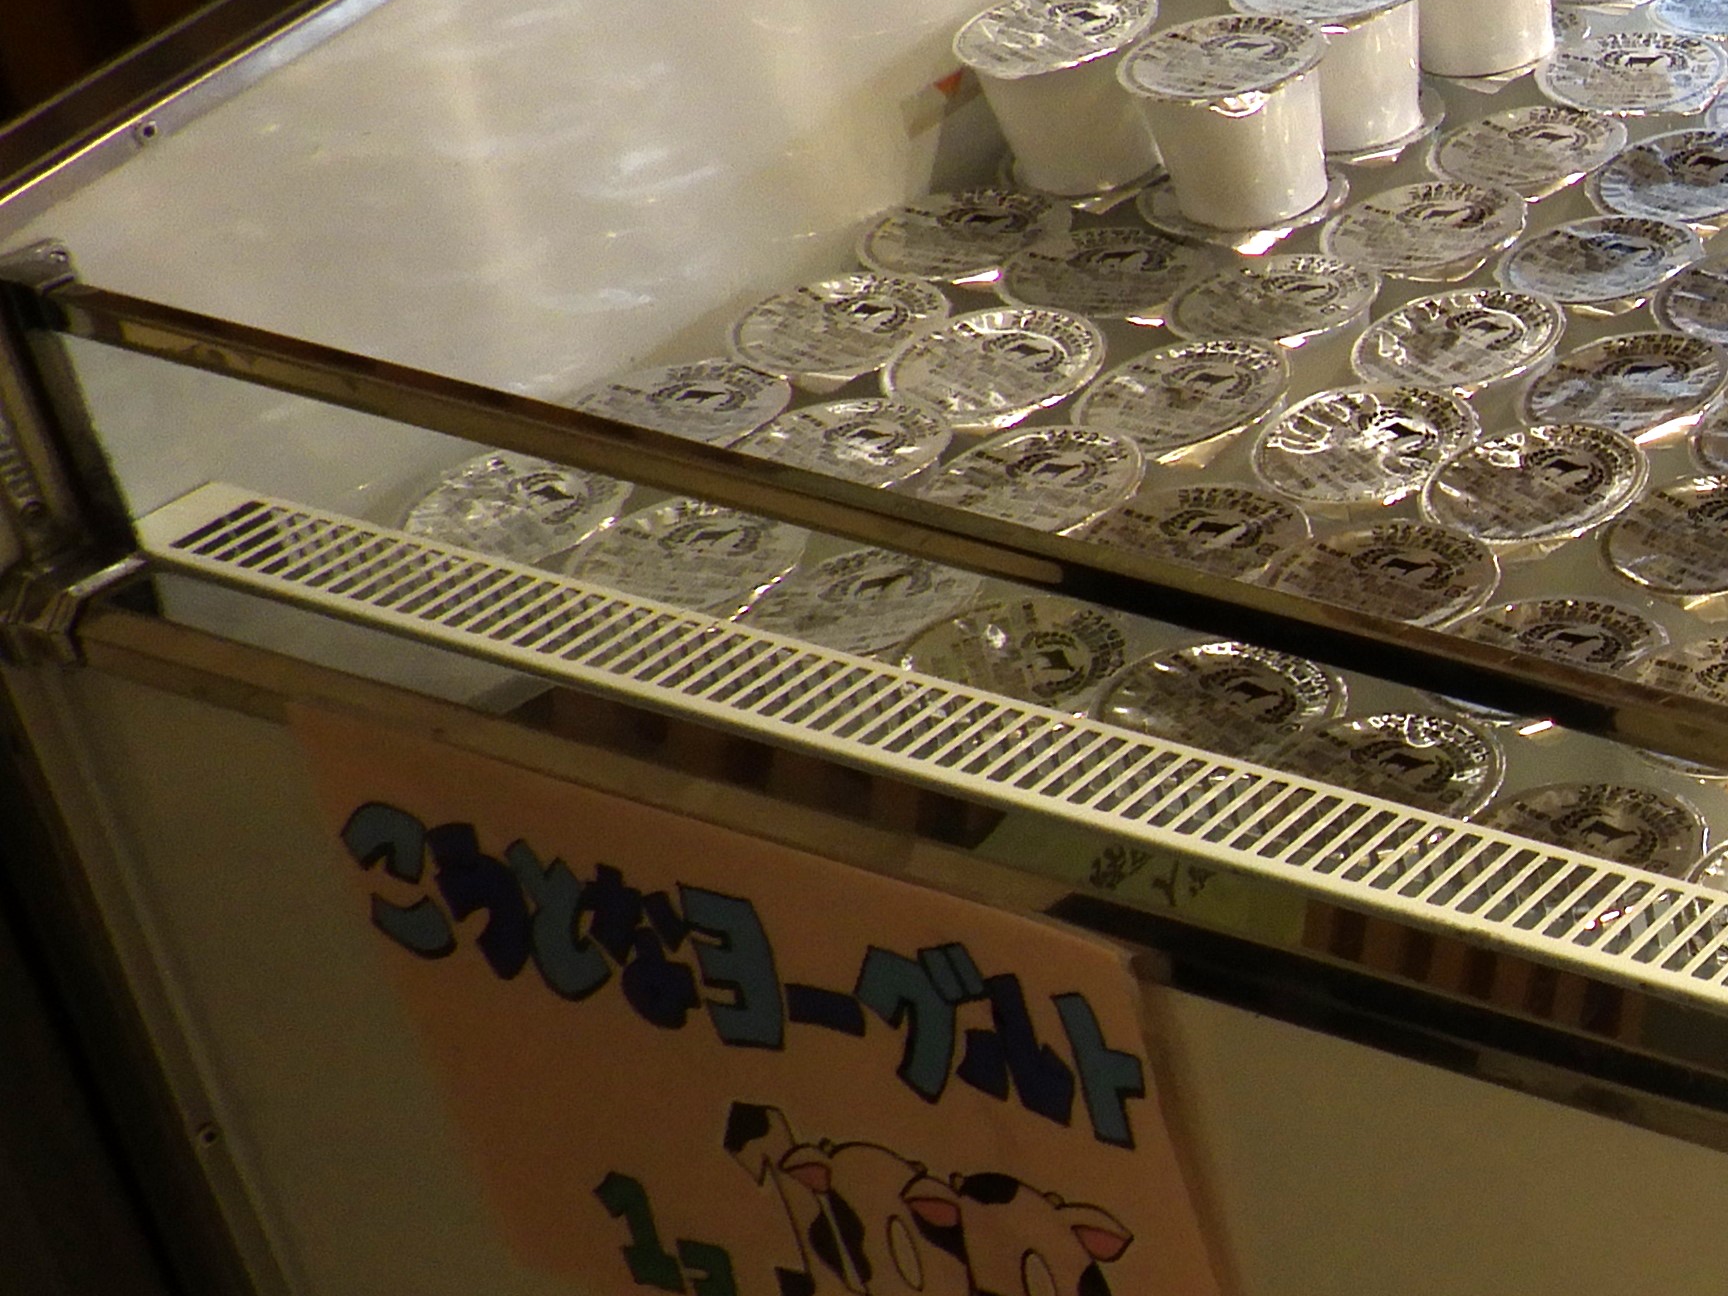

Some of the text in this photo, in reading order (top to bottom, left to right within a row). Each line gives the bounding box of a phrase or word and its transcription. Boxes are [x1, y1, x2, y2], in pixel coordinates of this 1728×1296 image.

[340, 801, 1143, 1149] こうとなヨーグルト
